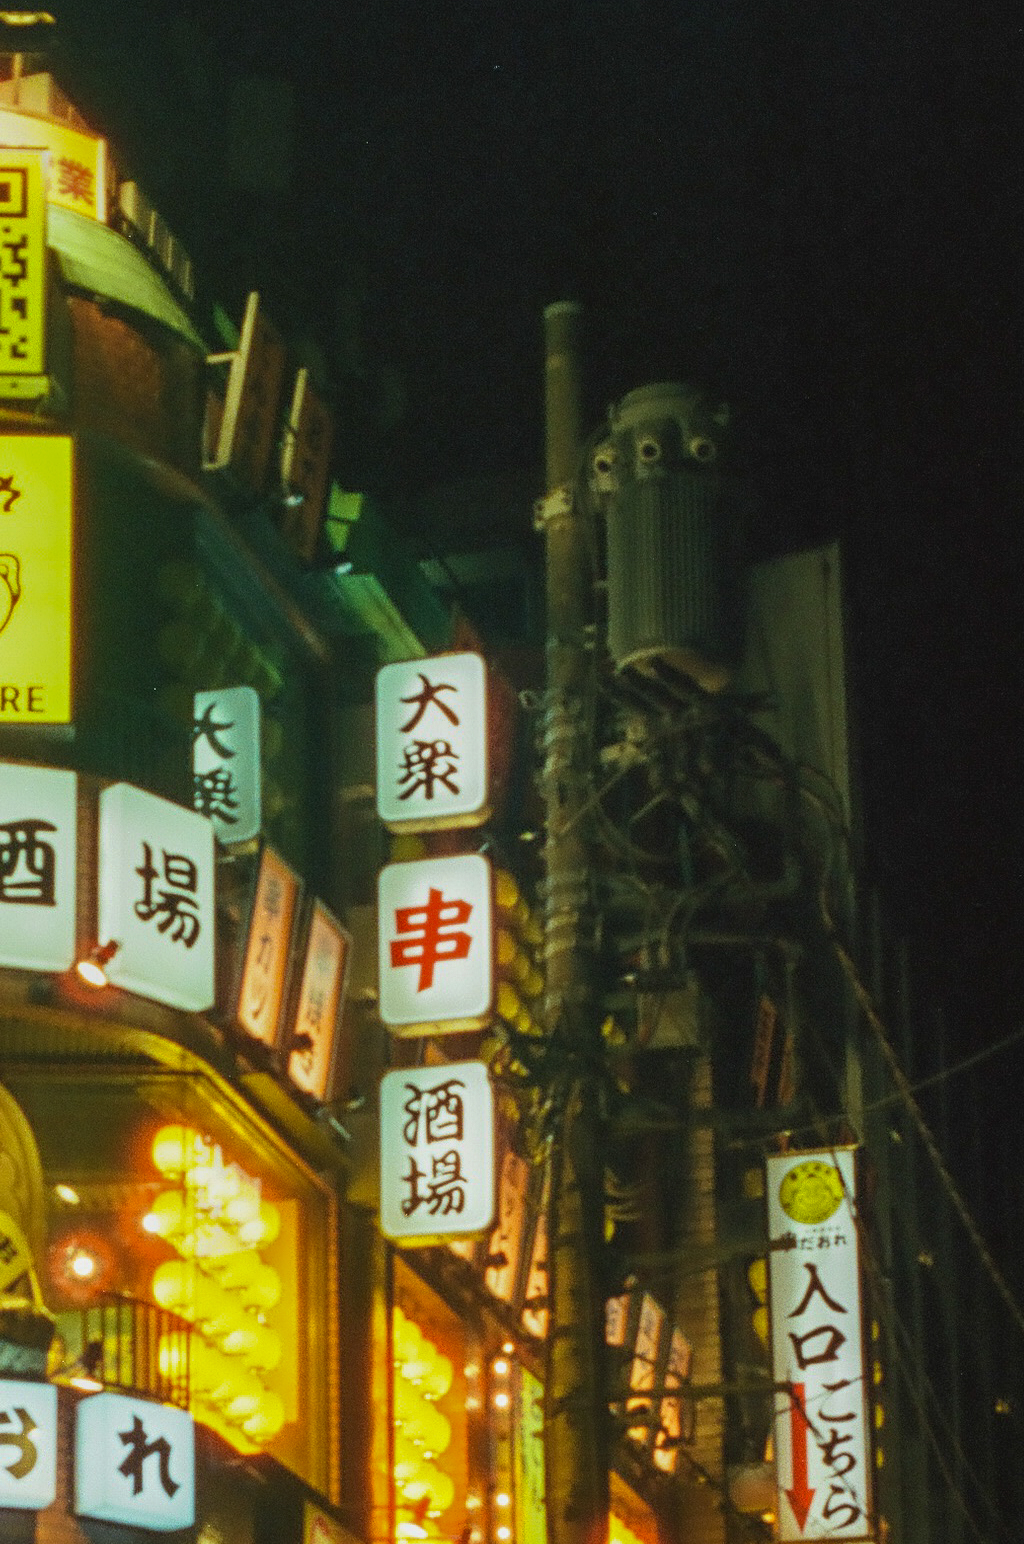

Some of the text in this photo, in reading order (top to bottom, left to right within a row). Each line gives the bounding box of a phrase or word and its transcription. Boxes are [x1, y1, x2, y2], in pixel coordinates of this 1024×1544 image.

[398, 673, 462, 801] 大衆
[389, 888, 475, 993] 串
[401, 1080, 469, 1218] 酒場
